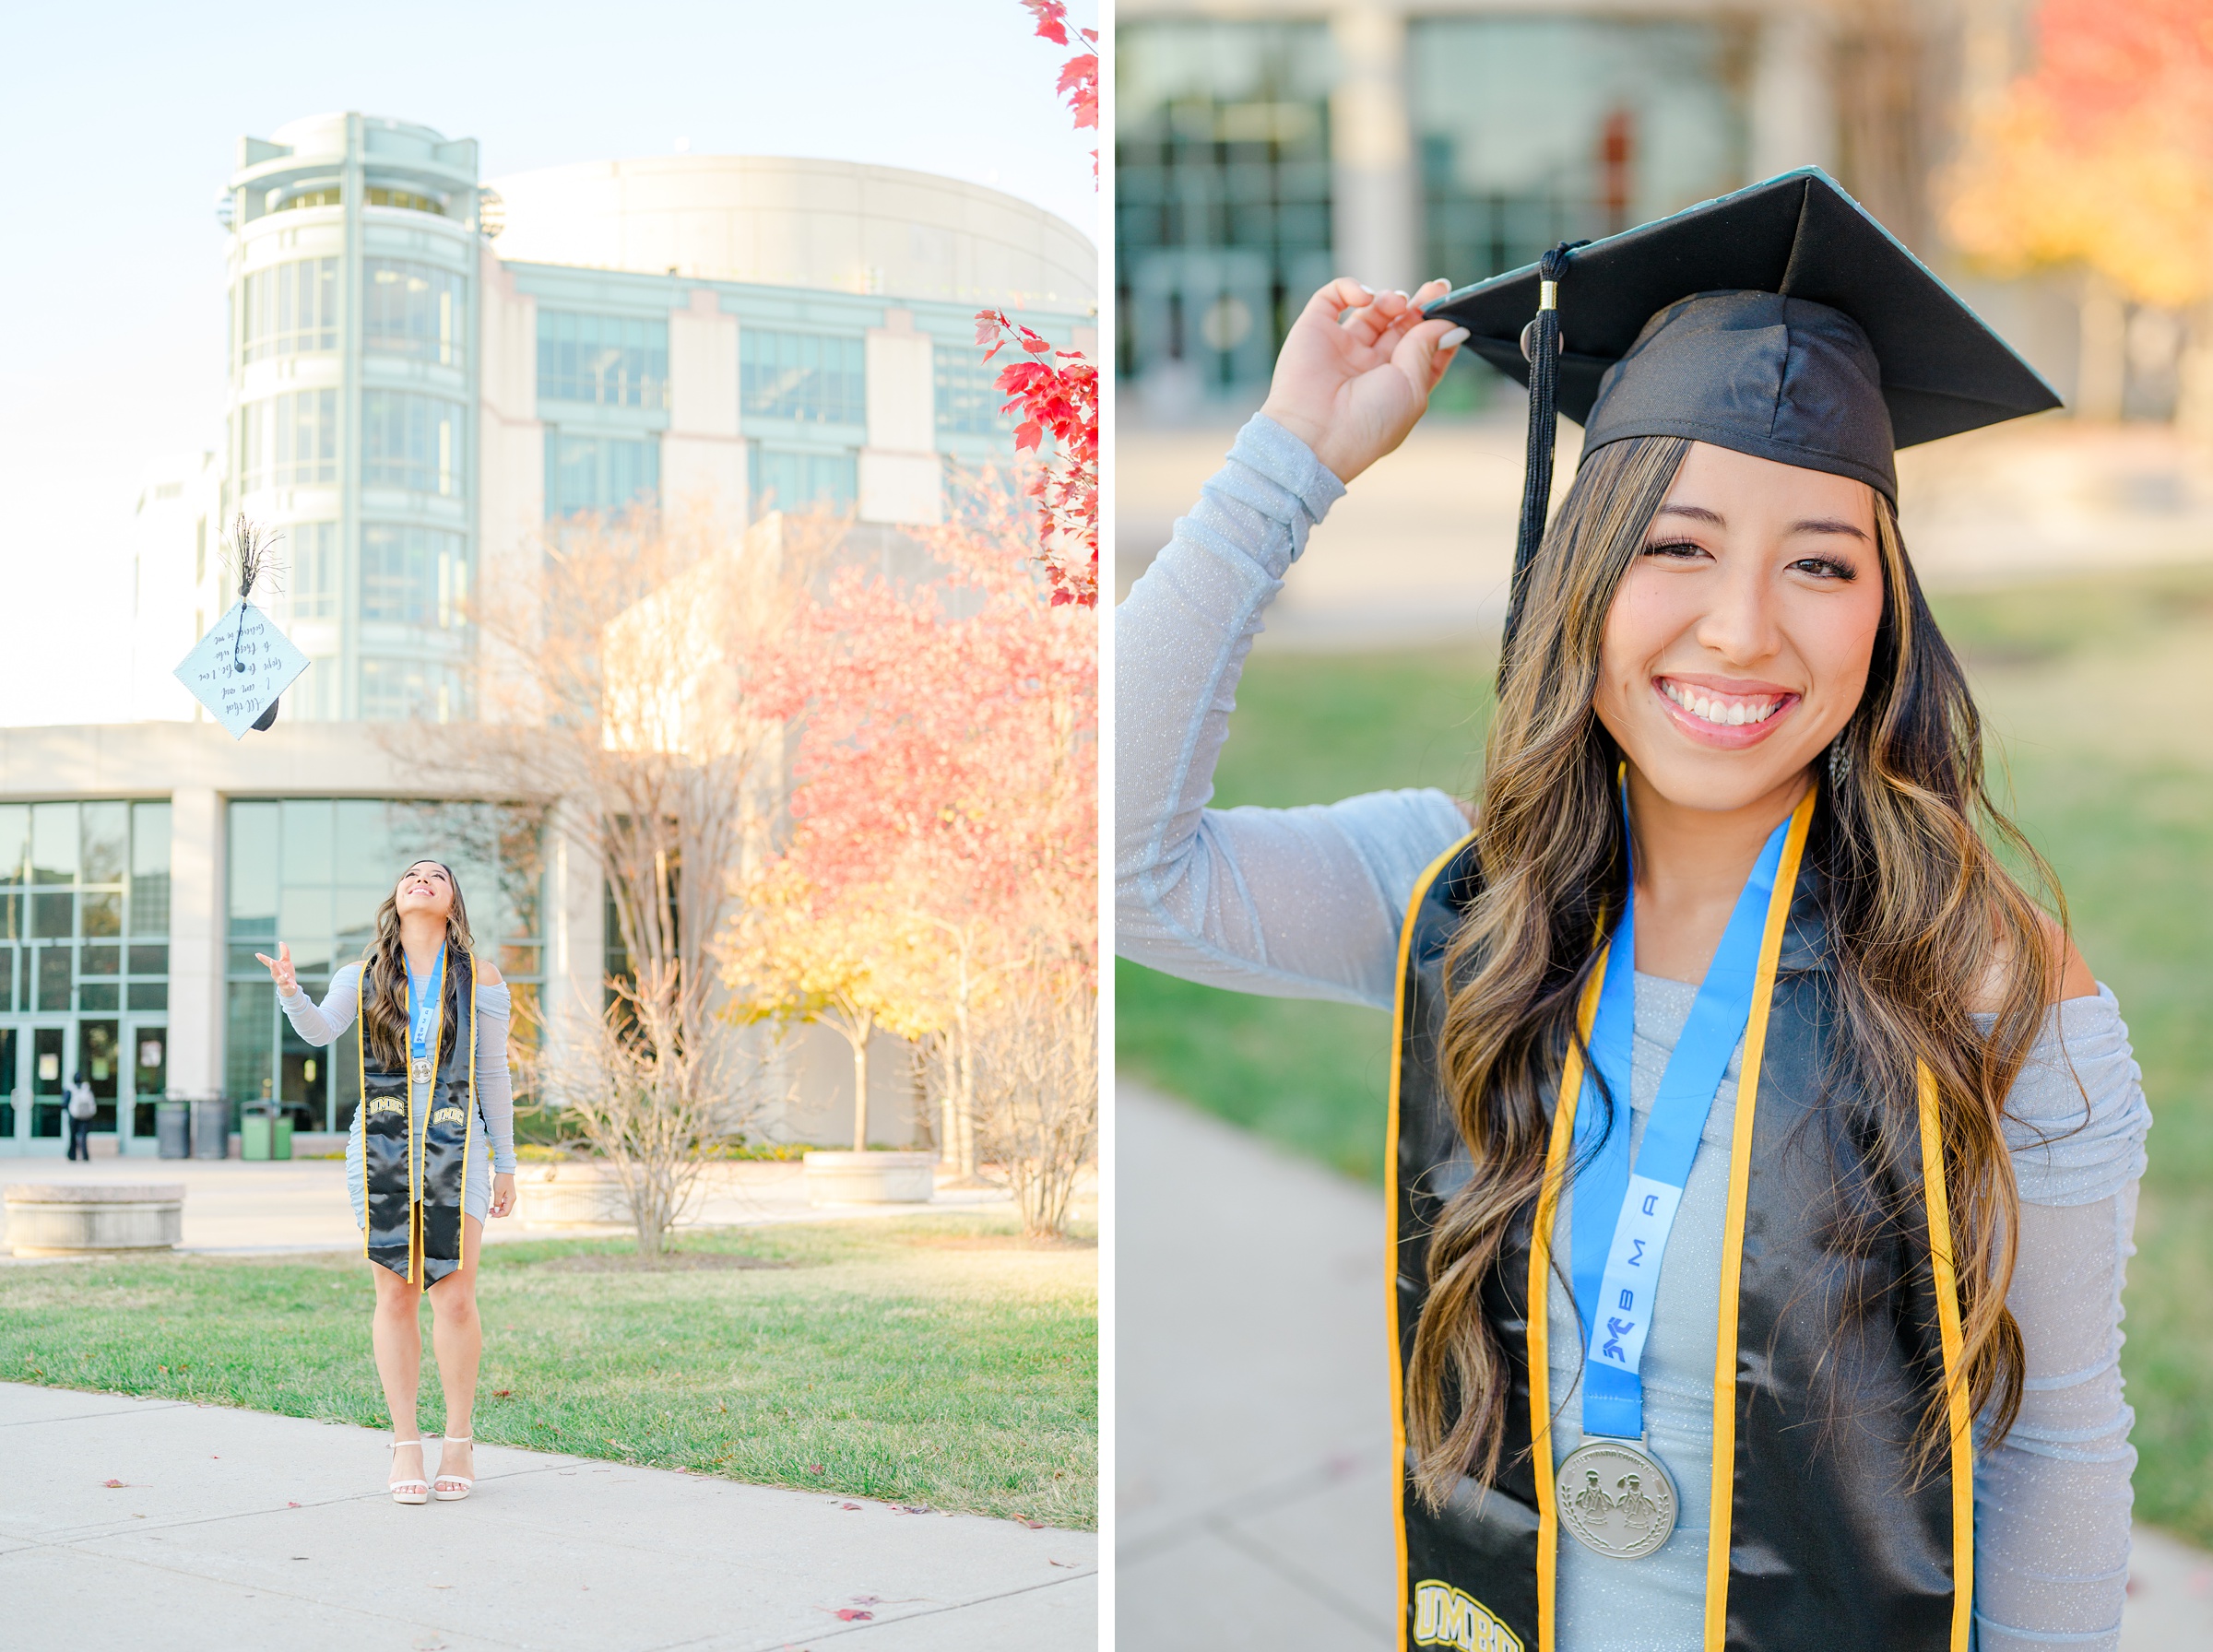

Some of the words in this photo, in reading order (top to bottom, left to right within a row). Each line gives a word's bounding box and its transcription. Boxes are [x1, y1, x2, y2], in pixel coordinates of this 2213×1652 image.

[214, 636, 225, 645] me
[214, 650, 230, 661] who
[248, 663, 256, 676] to
[263, 657, 282, 670] hope
[221, 688, 236, 700] and
[241, 684, 254, 693] am
[225, 702, 243, 716] that
[370, 1096, 405, 1115] UMBC
[432, 1107, 465, 1126] UMBC
